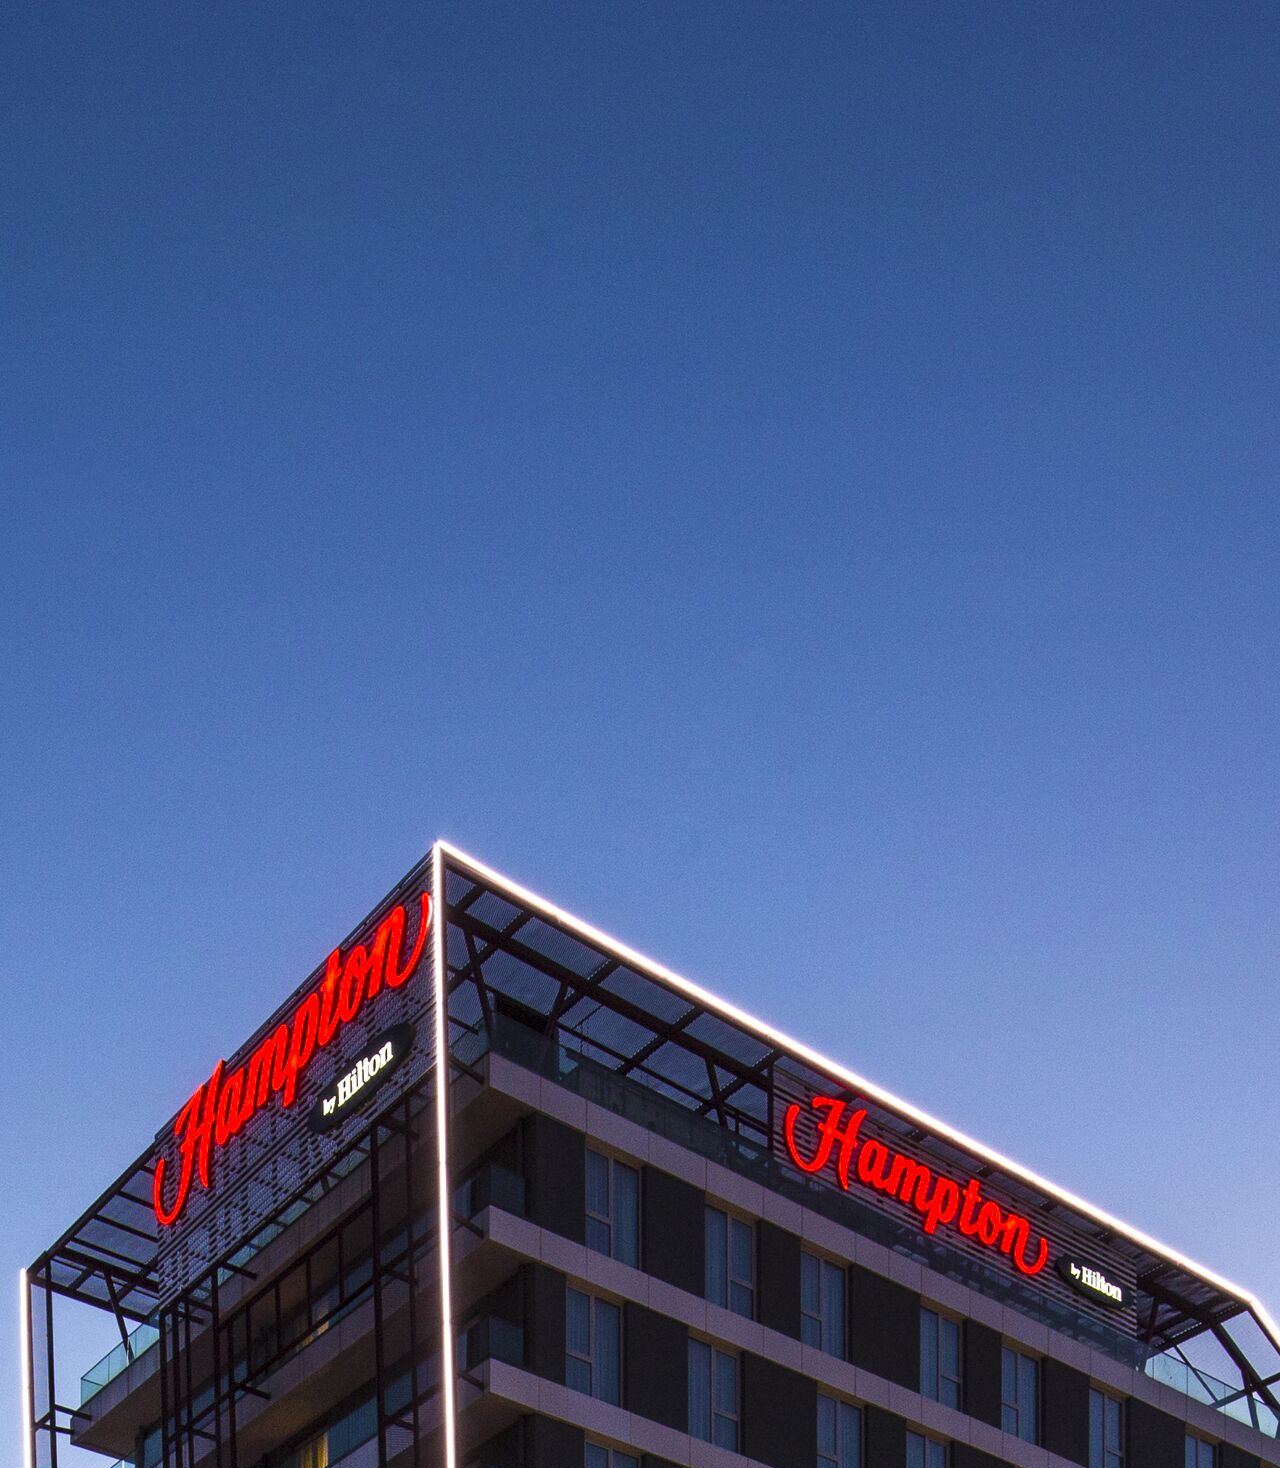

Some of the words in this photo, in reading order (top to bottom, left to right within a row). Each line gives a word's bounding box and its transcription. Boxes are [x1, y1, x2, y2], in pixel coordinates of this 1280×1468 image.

[154, 892, 432, 1226] Hampton
[322, 1095, 336, 1117] by
[337, 1040, 394, 1108] Hilton
[784, 1095, 1049, 1275] Hampton
[1070, 1262, 1081, 1280] by
[1081, 1266, 1122, 1303] Hilton
